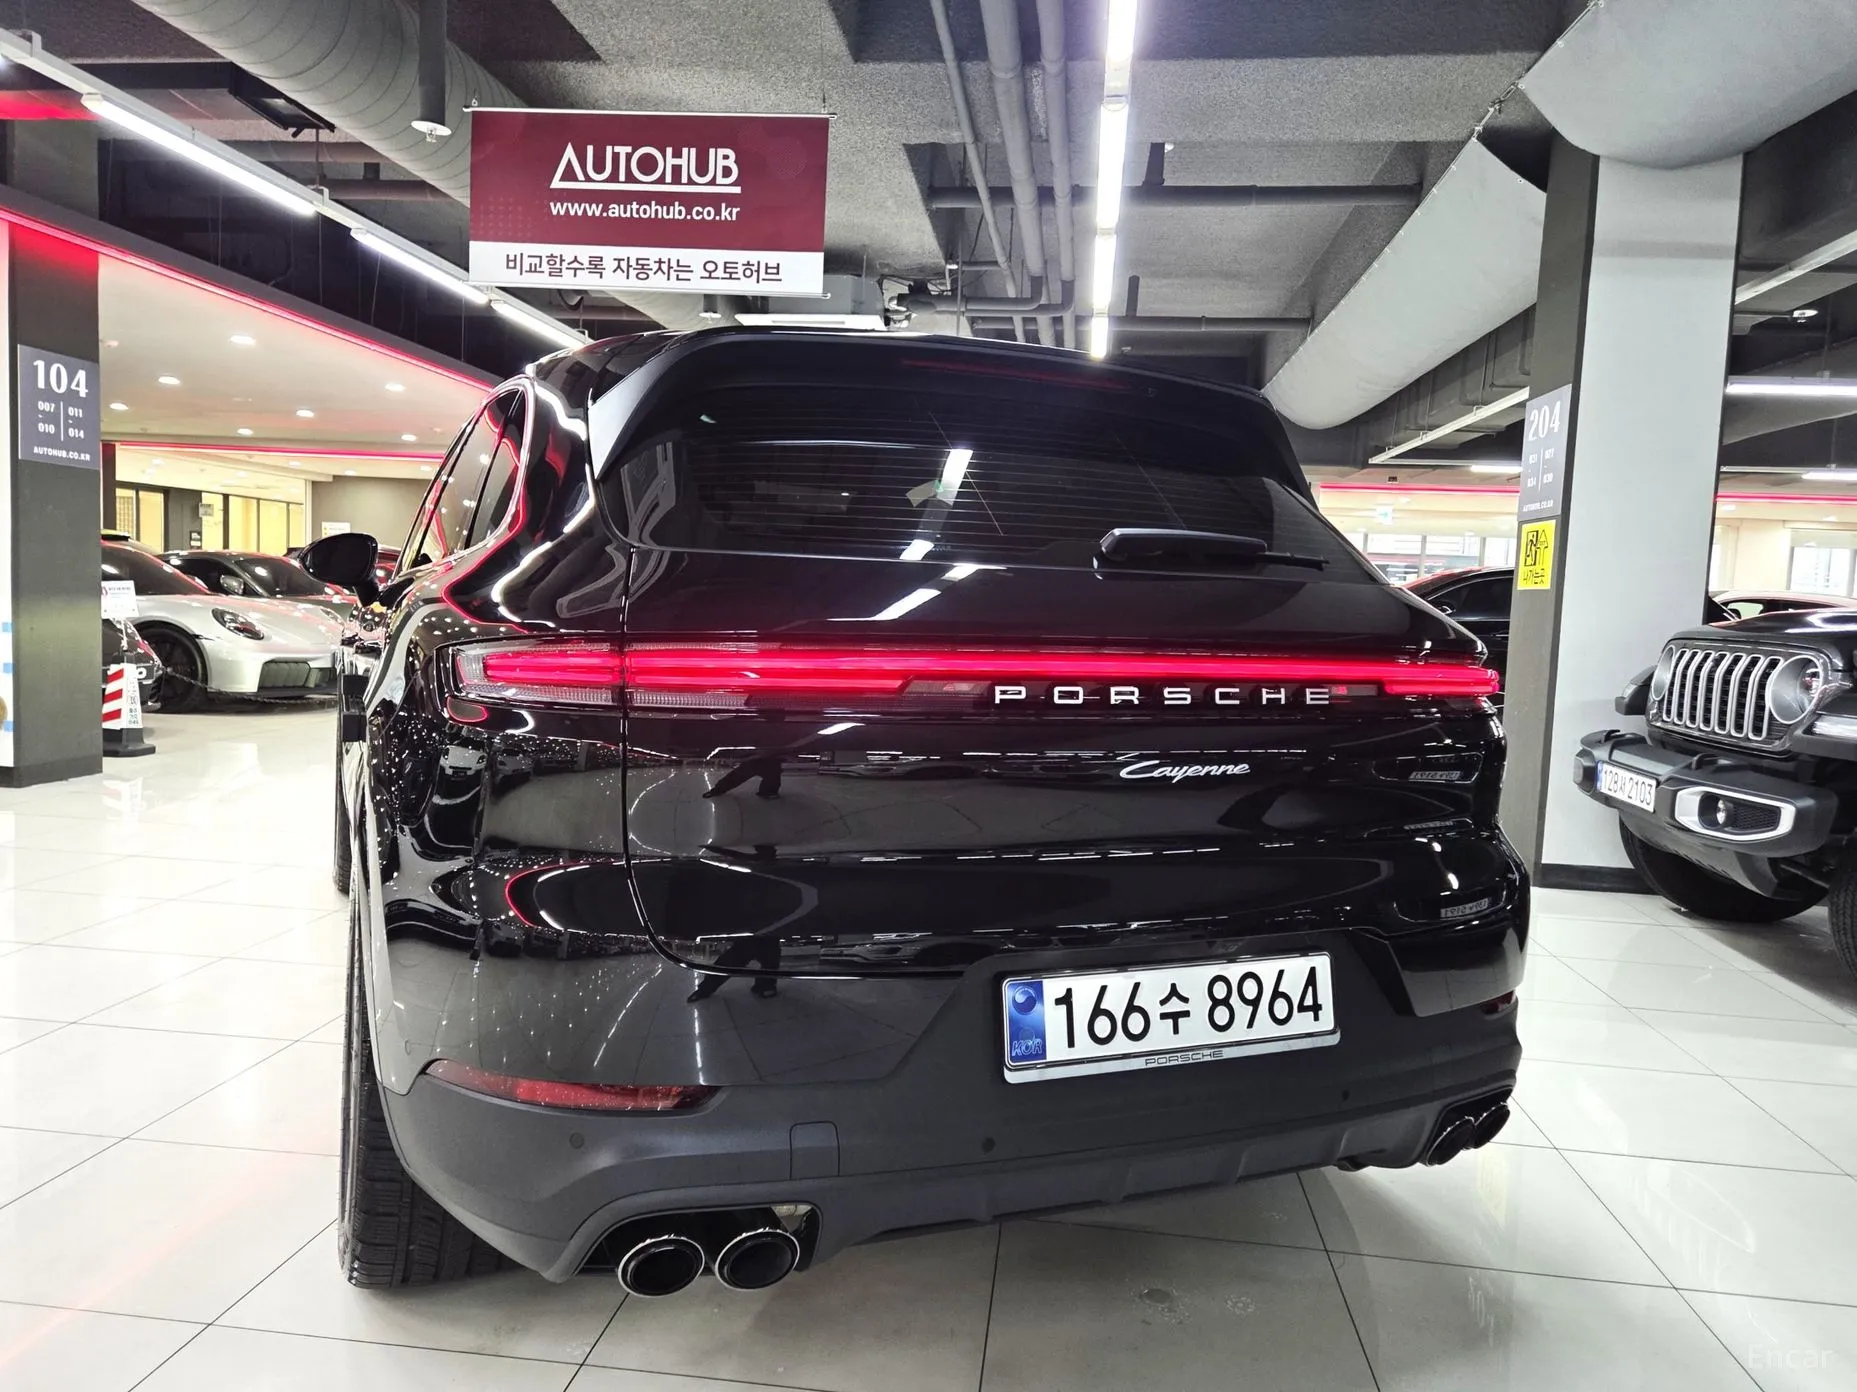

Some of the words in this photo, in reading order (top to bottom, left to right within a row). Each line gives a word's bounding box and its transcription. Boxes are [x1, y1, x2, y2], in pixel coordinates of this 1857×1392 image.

[550, 142, 741, 193] AUTOHUB
[550, 201, 741, 221] www.autohub.co.kr
[505, 253, 606, 279] 비교할수록
[612, 257, 694, 281] 자동차는
[700, 261, 782, 283] 오토허브
[33, 360, 89, 398] 104
[38, 401, 55, 412] 007
[68, 407, 83, 418] 011
[38, 423, 55, 434] 010
[1528, 401, 1560, 441] 204
[68, 428, 84, 439] 014
[33, 446, 91, 461] AUTOHUB.CO.KR
[994, 685, 1331, 705] PORSCHE
[1119, 758, 1251, 784] Cayenne
[1627, 777, 1653, 806] 2103
[1054, 982, 1191, 1048] 166수
[1207, 966, 1323, 1032] 8964
[1011, 1037, 1043, 1057] KOR
[1144, 1050, 1225, 1067] PORSCHE
